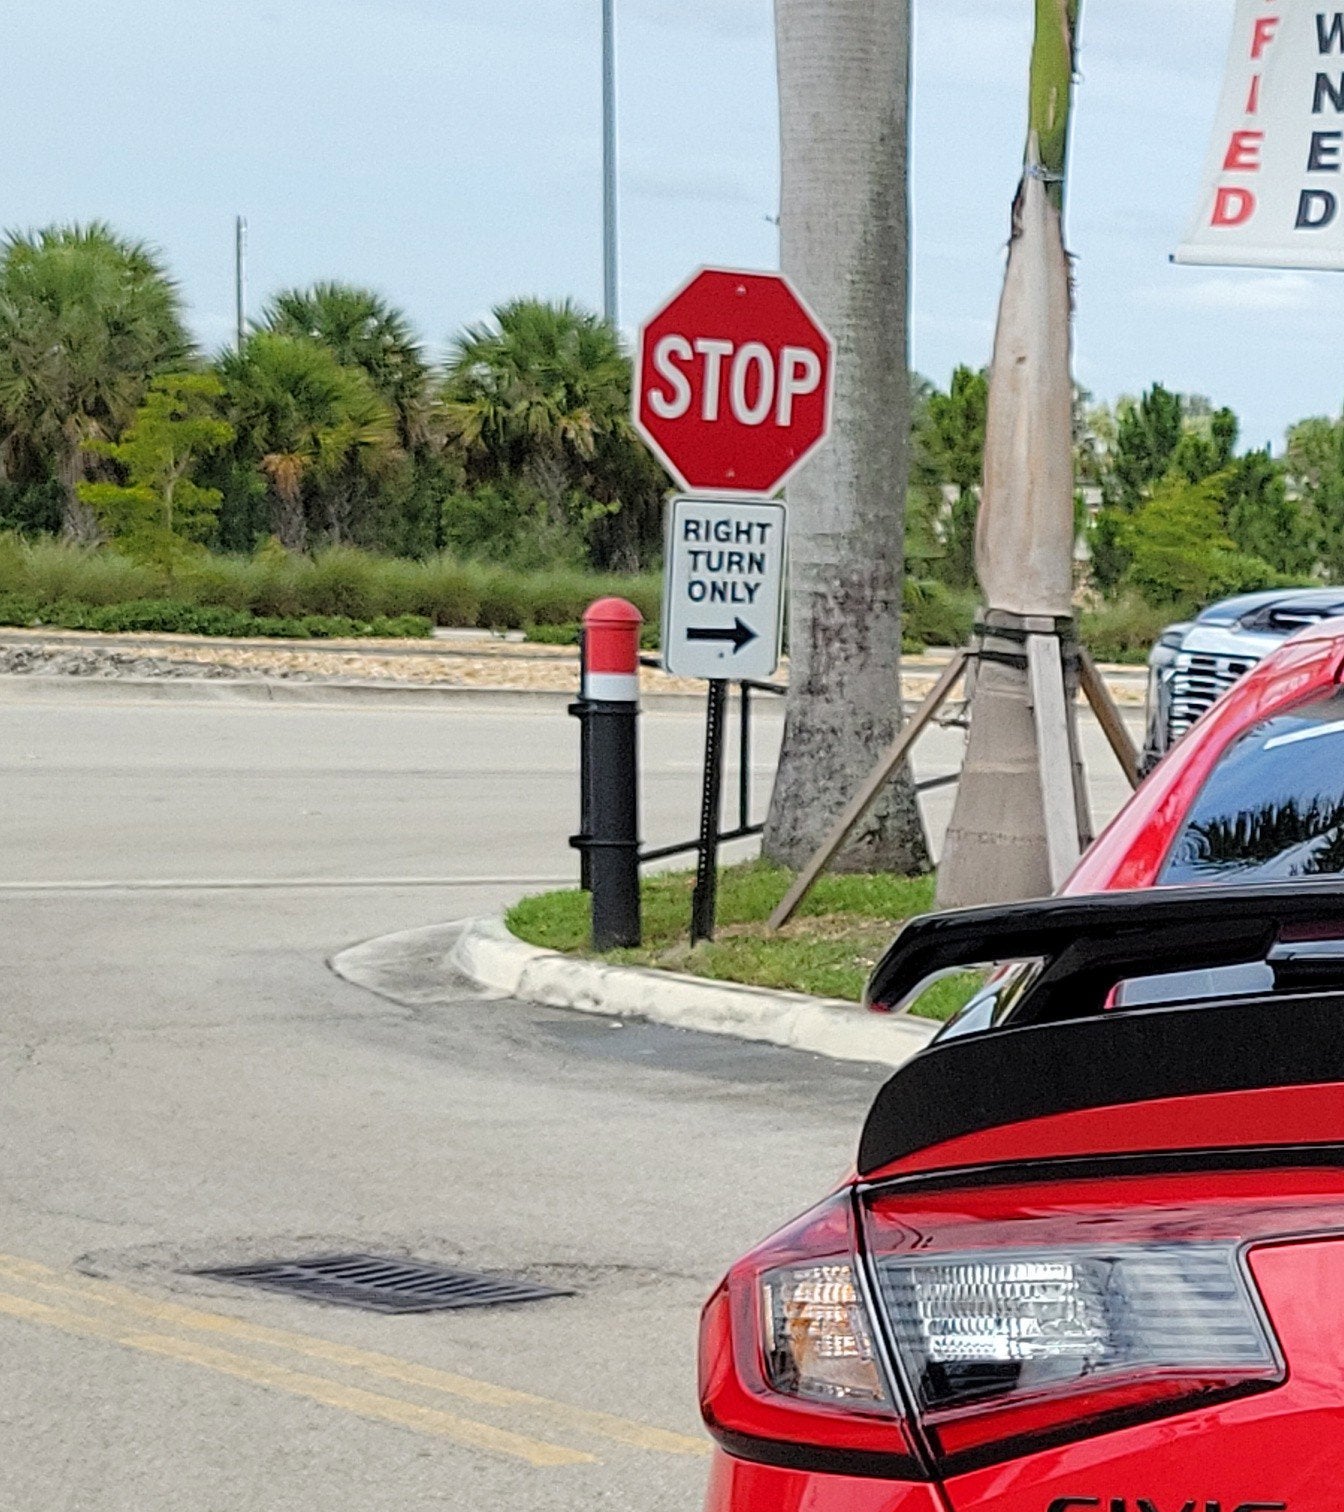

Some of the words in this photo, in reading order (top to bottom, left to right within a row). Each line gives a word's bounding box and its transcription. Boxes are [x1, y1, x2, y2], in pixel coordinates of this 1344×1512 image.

[1210, 0, 1280, 228] FIED
[647, 333, 821, 427] STOP
[684, 519, 772, 545] RIGHT
[688, 550, 766, 575] TURN
[688, 580, 762, 604] ONLY
